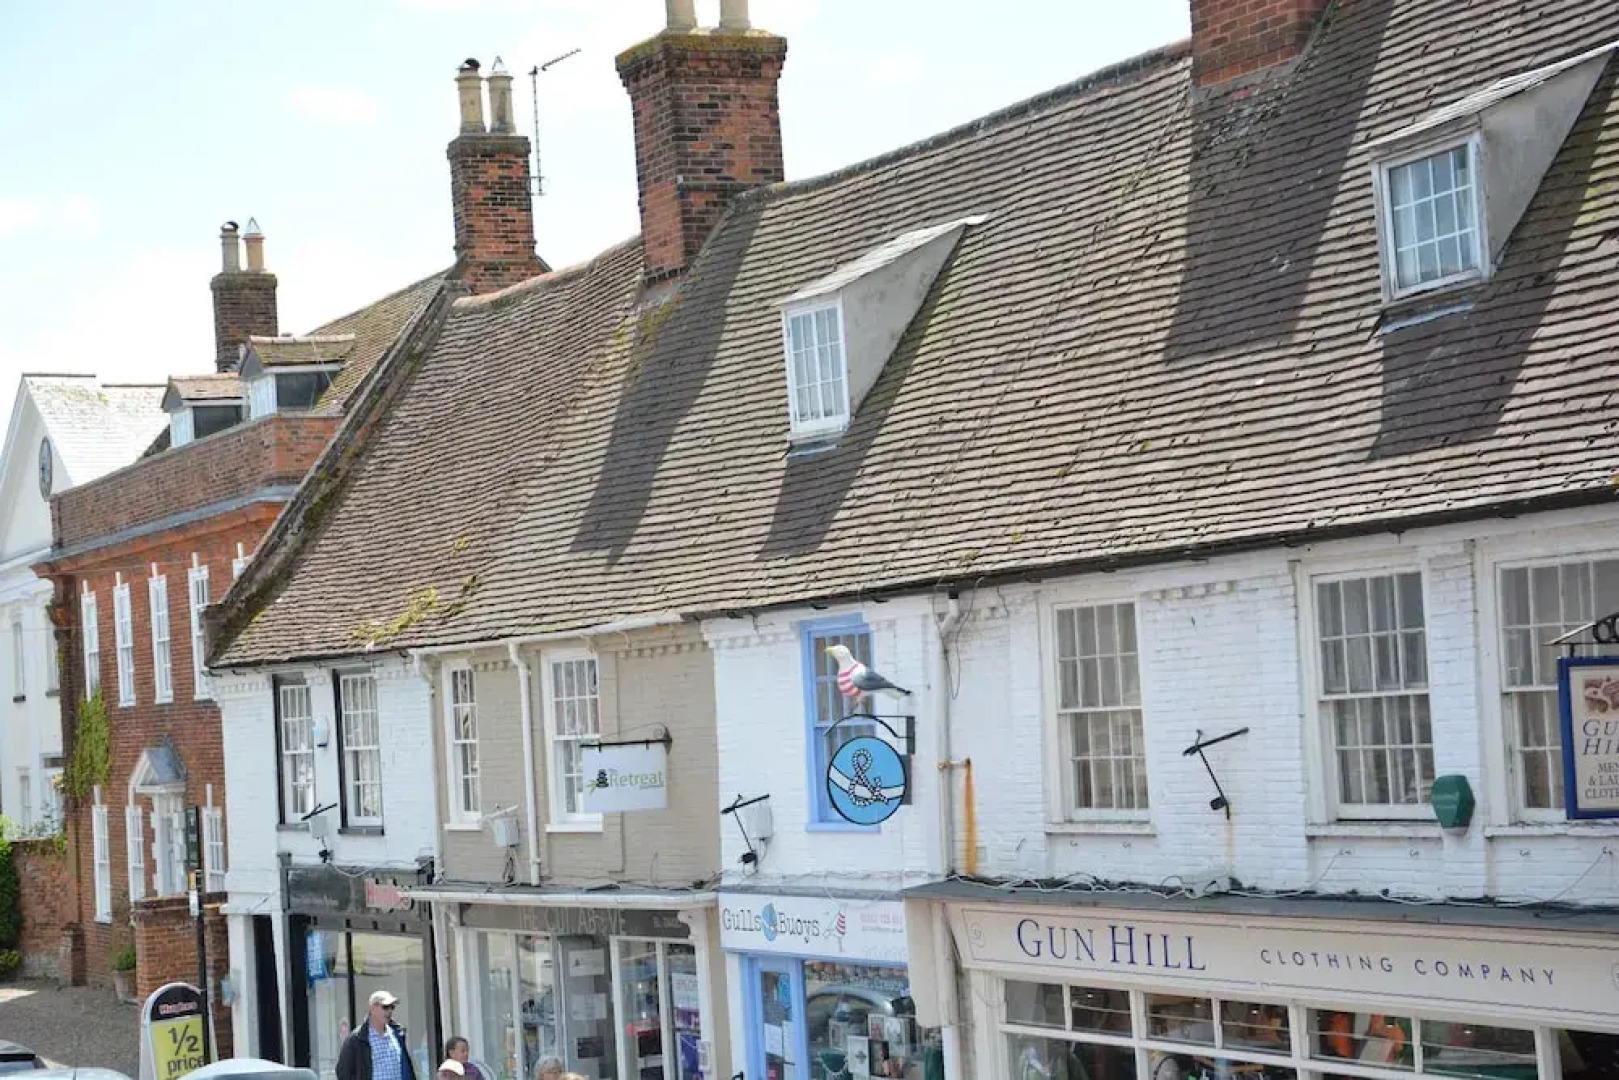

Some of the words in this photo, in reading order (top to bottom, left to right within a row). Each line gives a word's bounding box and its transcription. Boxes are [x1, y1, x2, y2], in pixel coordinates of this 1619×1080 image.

[1583, 719, 1619, 737] GU
[1582, 738, 1619, 755] HI
[609, 770, 662, 788] Retreat
[723, 907, 762, 932] Gulls
[778, 912, 820, 944] Buoys
[1017, 919, 1096, 962] GUN
[1108, 925, 1206, 971] HILL
[1260, 949, 1393, 972] CLOTHING
[1414, 959, 1554, 985] COMPANY
[167, 1054, 205, 1076] price
